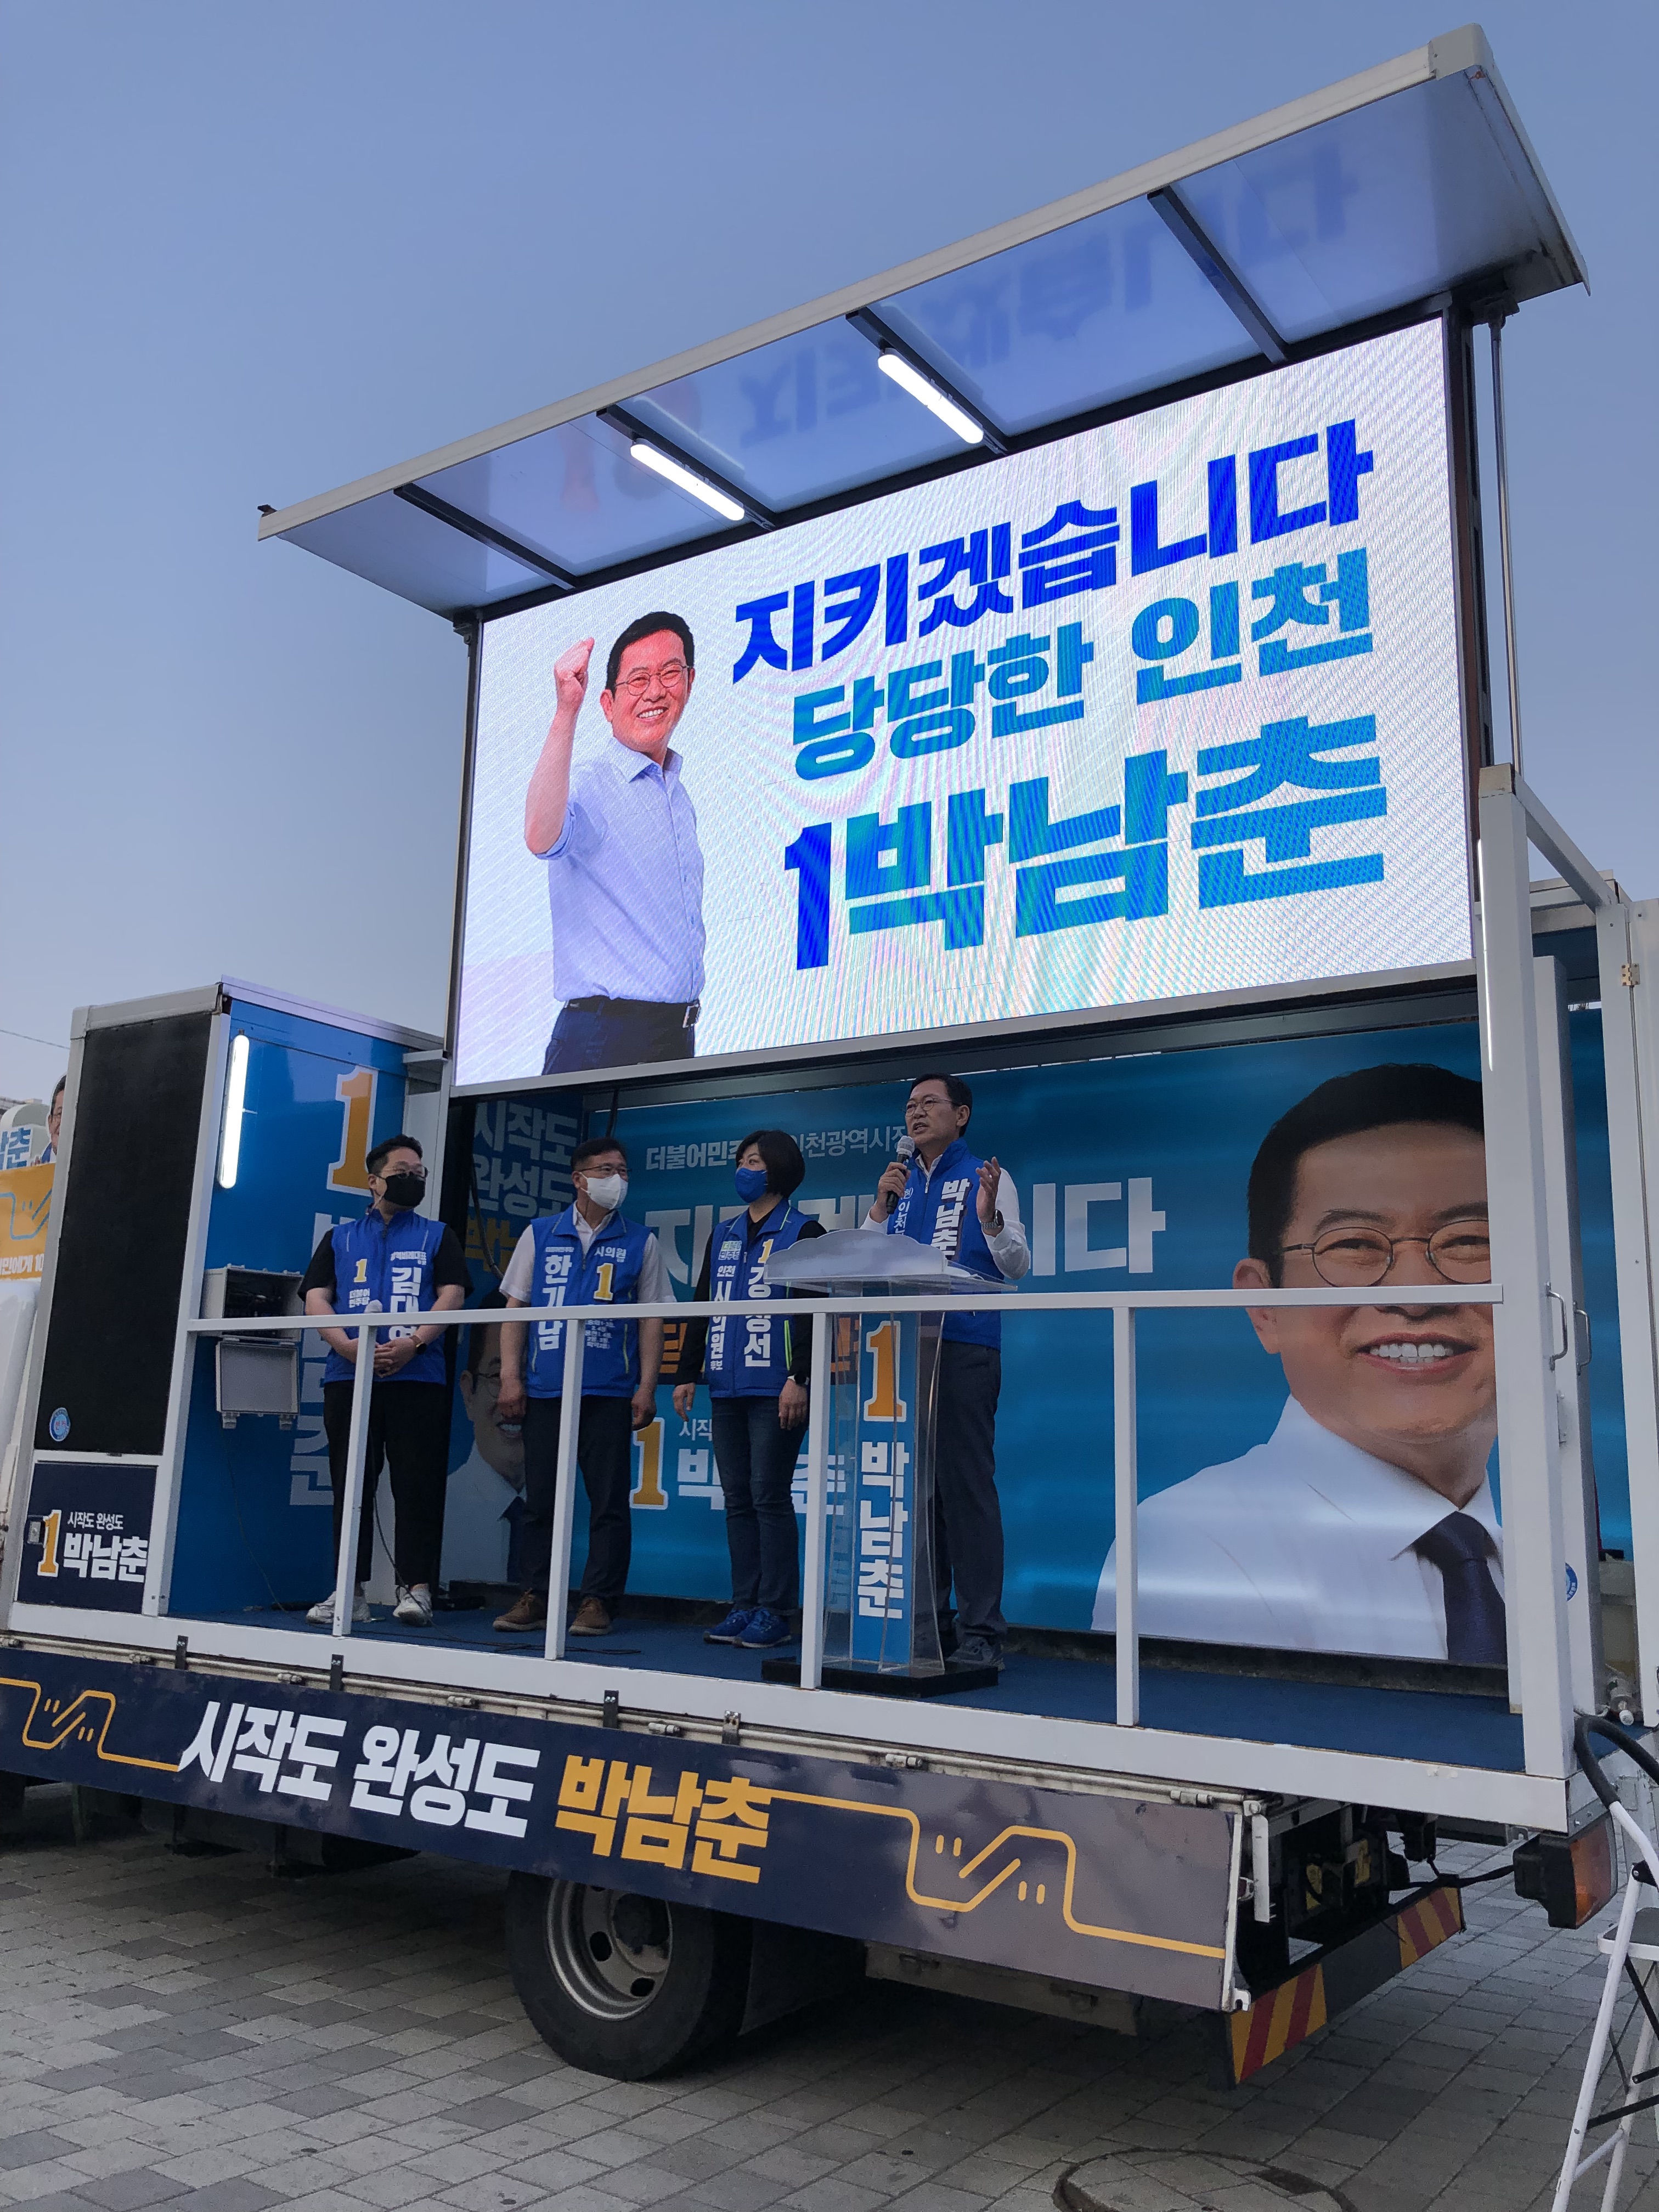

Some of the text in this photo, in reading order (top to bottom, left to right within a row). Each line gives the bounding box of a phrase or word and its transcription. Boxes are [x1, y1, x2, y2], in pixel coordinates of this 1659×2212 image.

[733, 418, 1374, 684] 지키겠습니다
[794, 547, 1373, 781] 당당한 인천
[327, 1065, 378, 1196] 1
[475, 1101, 578, 1165] 시작도
[646, 1126, 907, 1170] 더불어민 천광역시
[469, 1154, 574, 1217] 완성도
[930, 1178, 970, 1256] 박남춘
[353, 1259, 368, 1283] 1
[594, 1262, 614, 1301] 1
[595, 1246, 627, 1260] 시의원
[716, 1265, 736, 1277] 인천
[758, 1239, 774, 1263] 1
[538, 1255, 572, 1350] 한기남
[864, 1321, 907, 1421] 1
[679, 1418, 713, 1441] 시작
[629, 1417, 668, 1510] 1
[37, 1510, 61, 1577] 1
[67, 1511, 124, 1531] 시작도 완성도
[857, 1441, 910, 1619] 박남춘
[64, 1533, 148, 1583] 박남춘
[178, 1701, 770, 1884] 시작도 완성도 박남춘
